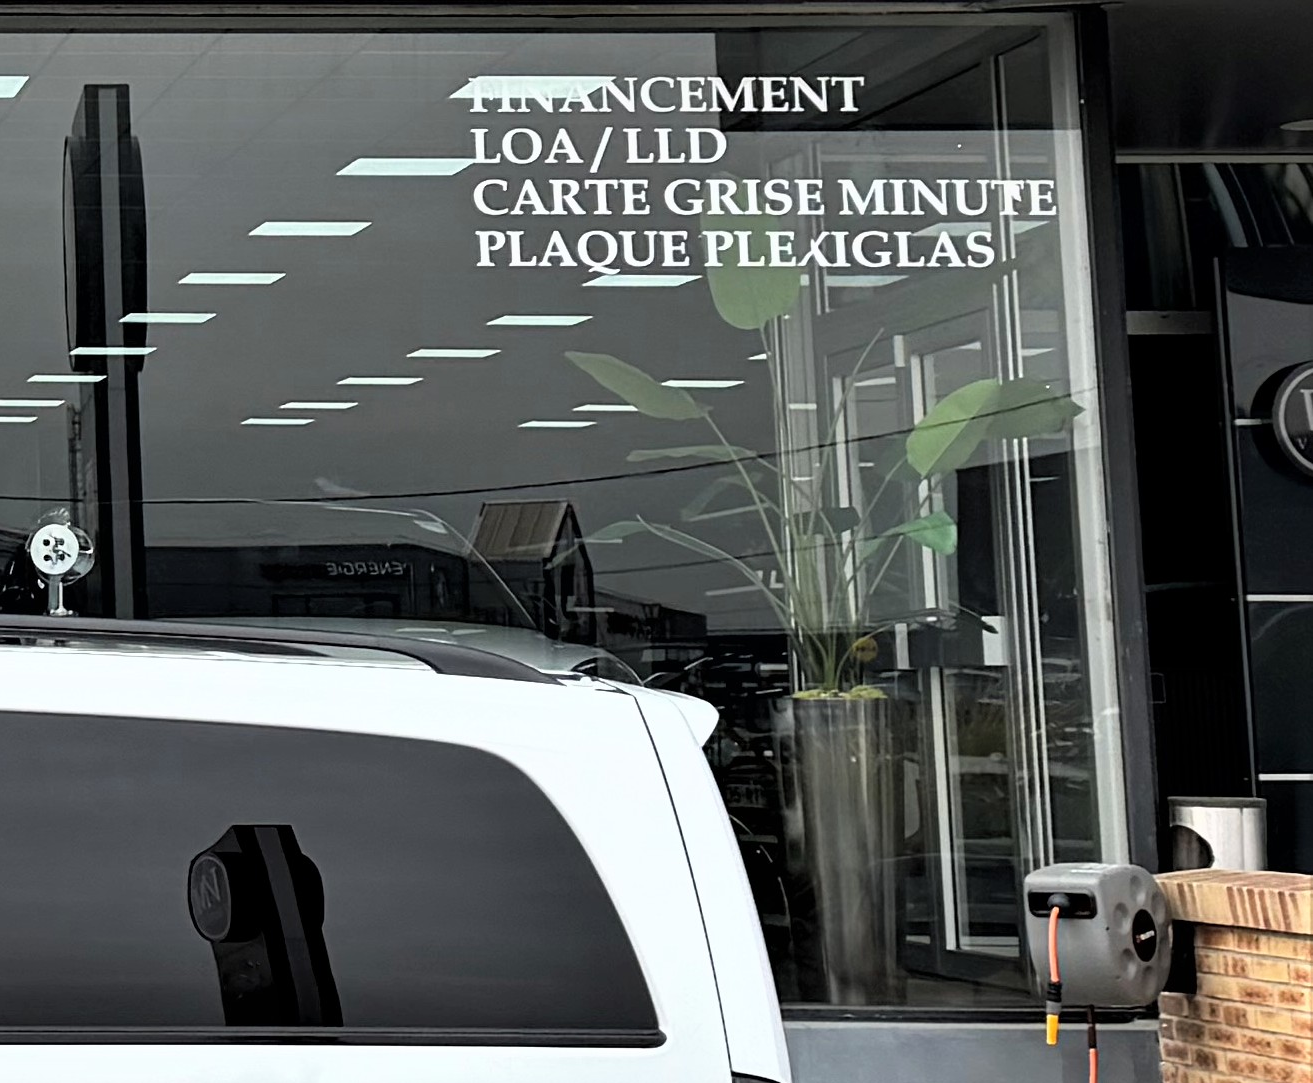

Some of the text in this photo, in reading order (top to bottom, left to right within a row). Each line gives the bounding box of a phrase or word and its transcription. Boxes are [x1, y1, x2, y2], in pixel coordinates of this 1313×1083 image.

[468, 76, 865, 113] FINANCEMENT
[469, 127, 584, 165] LOA
[622, 127, 727, 164] LLD
[473, 178, 1057, 216] CARTE GRISE MINUTE
[475, 229, 995, 275] PLAQUE PLEXIGLAS
